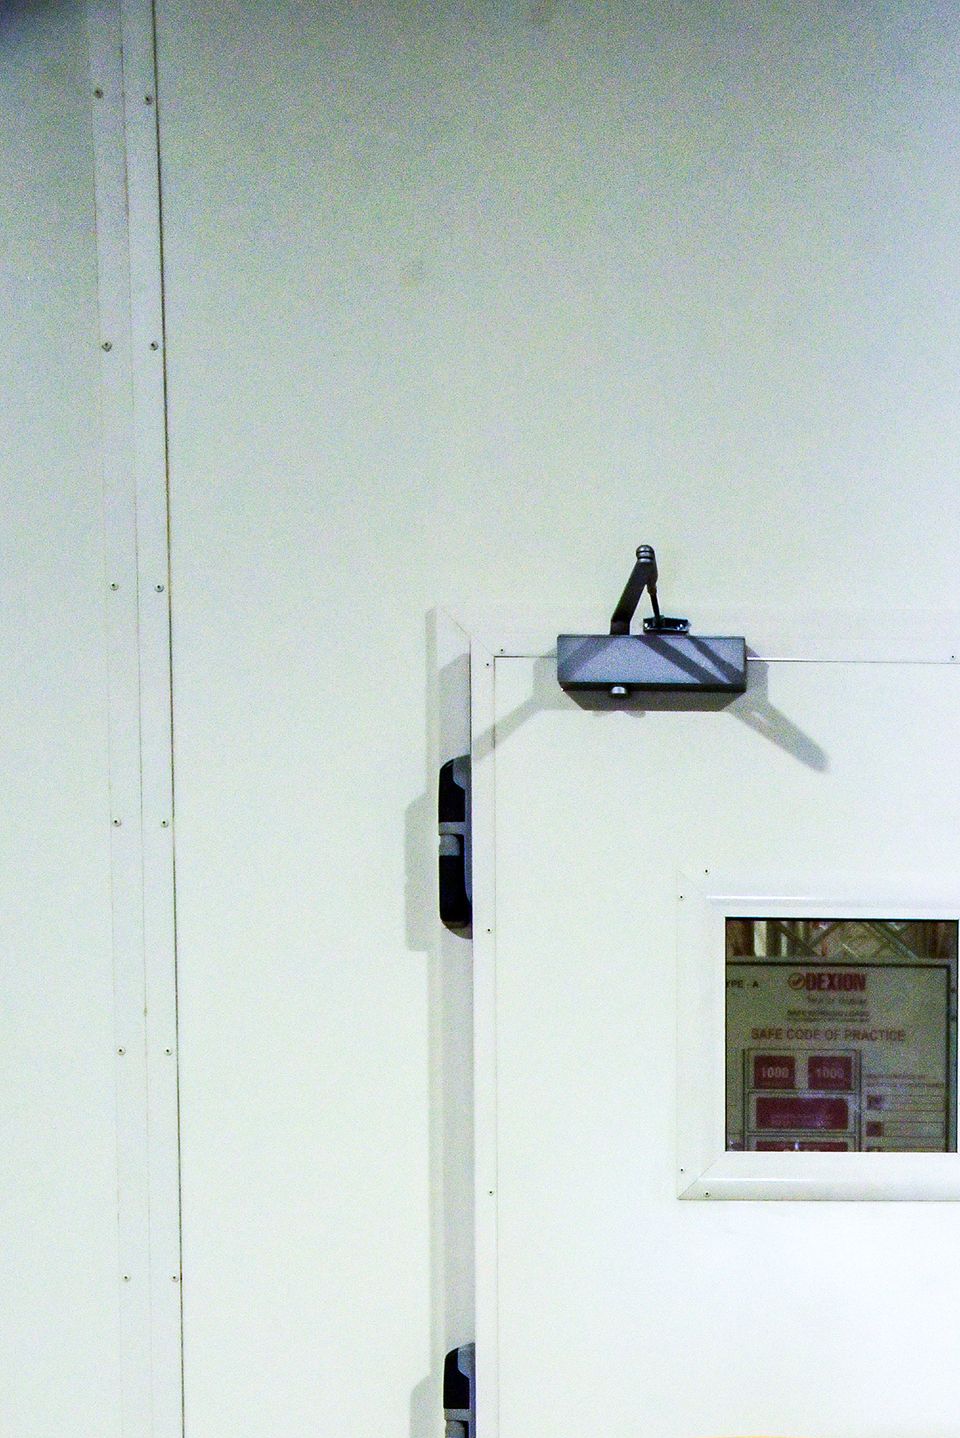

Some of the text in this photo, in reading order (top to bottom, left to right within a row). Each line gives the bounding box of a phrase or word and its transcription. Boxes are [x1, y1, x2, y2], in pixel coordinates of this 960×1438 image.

[805, 972, 867, 991] DEXION
[751, 1028, 906, 1042] SAFE CODE OF PRACTICE
